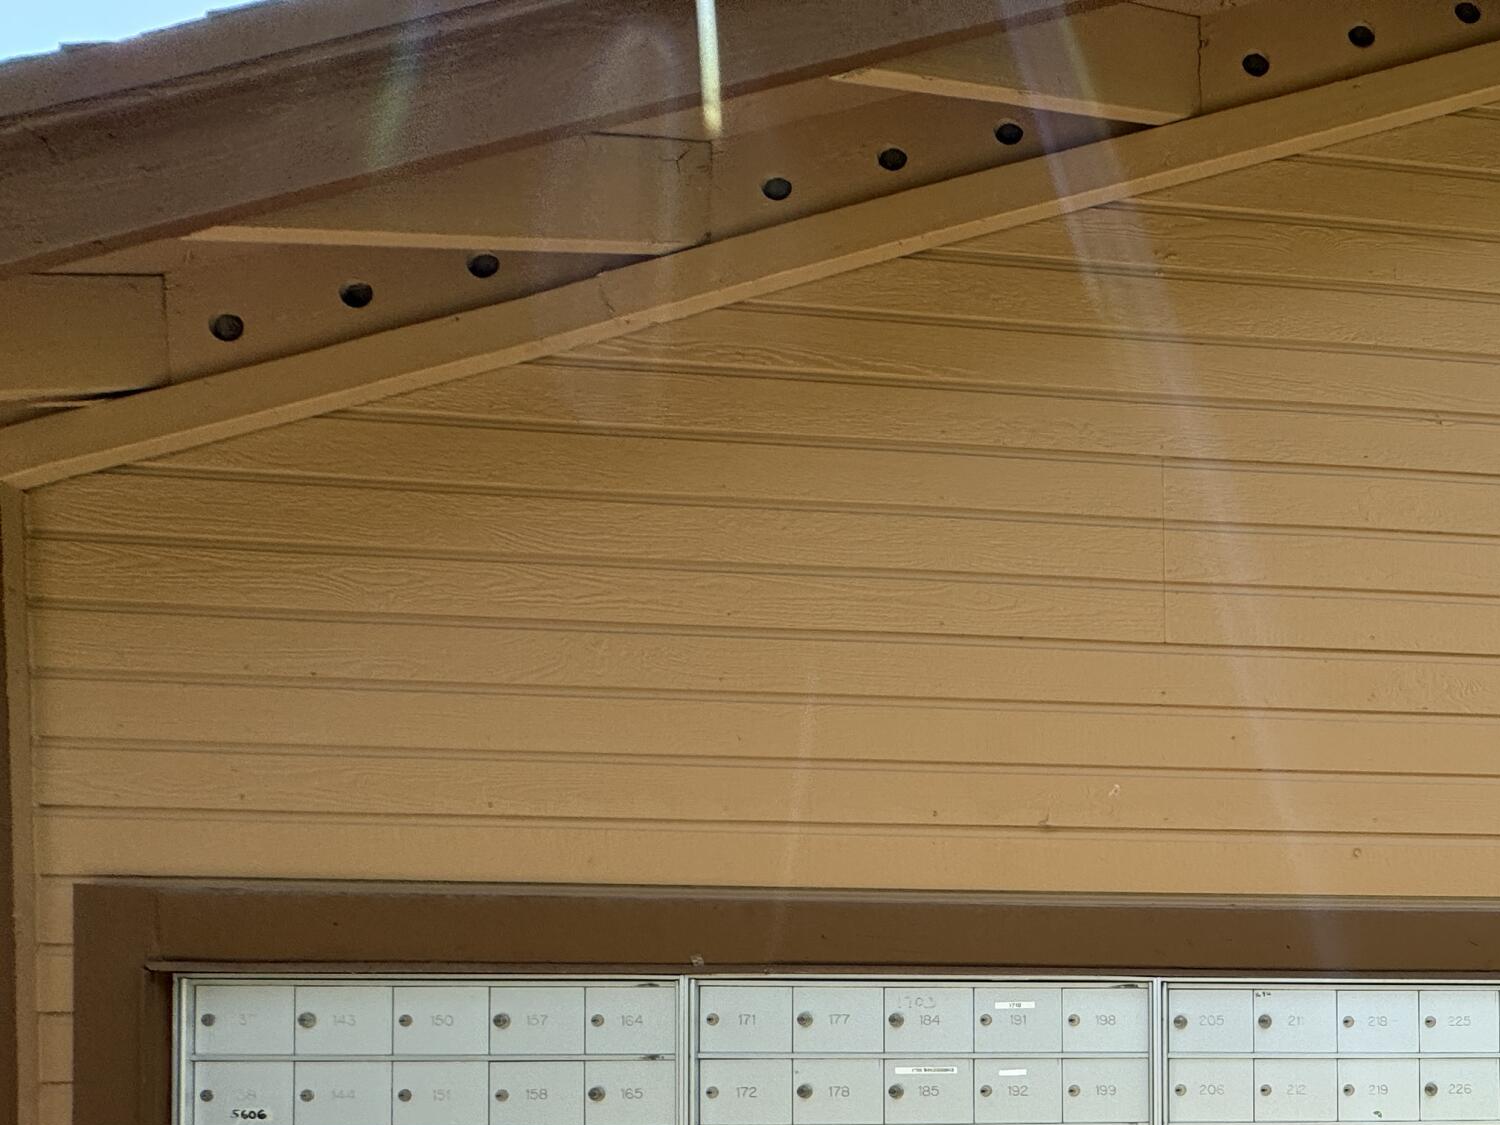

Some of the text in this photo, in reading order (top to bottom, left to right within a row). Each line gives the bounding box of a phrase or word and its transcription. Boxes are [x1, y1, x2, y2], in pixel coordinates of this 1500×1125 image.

[332, 1013, 356, 1027] 143
[430, 1014, 454, 1027] 150
[526, 1013, 549, 1027] 157
[621, 1014, 644, 1027] 164
[738, 1013, 757, 1026] 171
[828, 1013, 851, 1026] 177
[919, 1014, 941, 1026] 184
[1009, 1014, 1027, 1026] 191
[1095, 1014, 1117, 1026] 198
[1199, 1015, 1225, 1027] 205
[1367, 1015, 1389, 1027] 218
[1448, 1015, 1472, 1027] 225
[525, 1088, 548, 1101] 158
[620, 1087, 644, 1100] 165
[736, 1086, 758, 1099] 172
[828, 1085, 851, 1098] 178
[918, 1085, 940, 1097] 185
[1007, 1085, 1029, 1097] 192
[1095, 1085, 1117, 1097] 199
[1199, 1084, 1225, 1096] 206
[1286, 1084, 1307, 1096] 212
[1368, 1084, 1389, 1096] 219
[1448, 1083, 1473, 1095] 226
[230, 1108, 269, 1121] 5606
